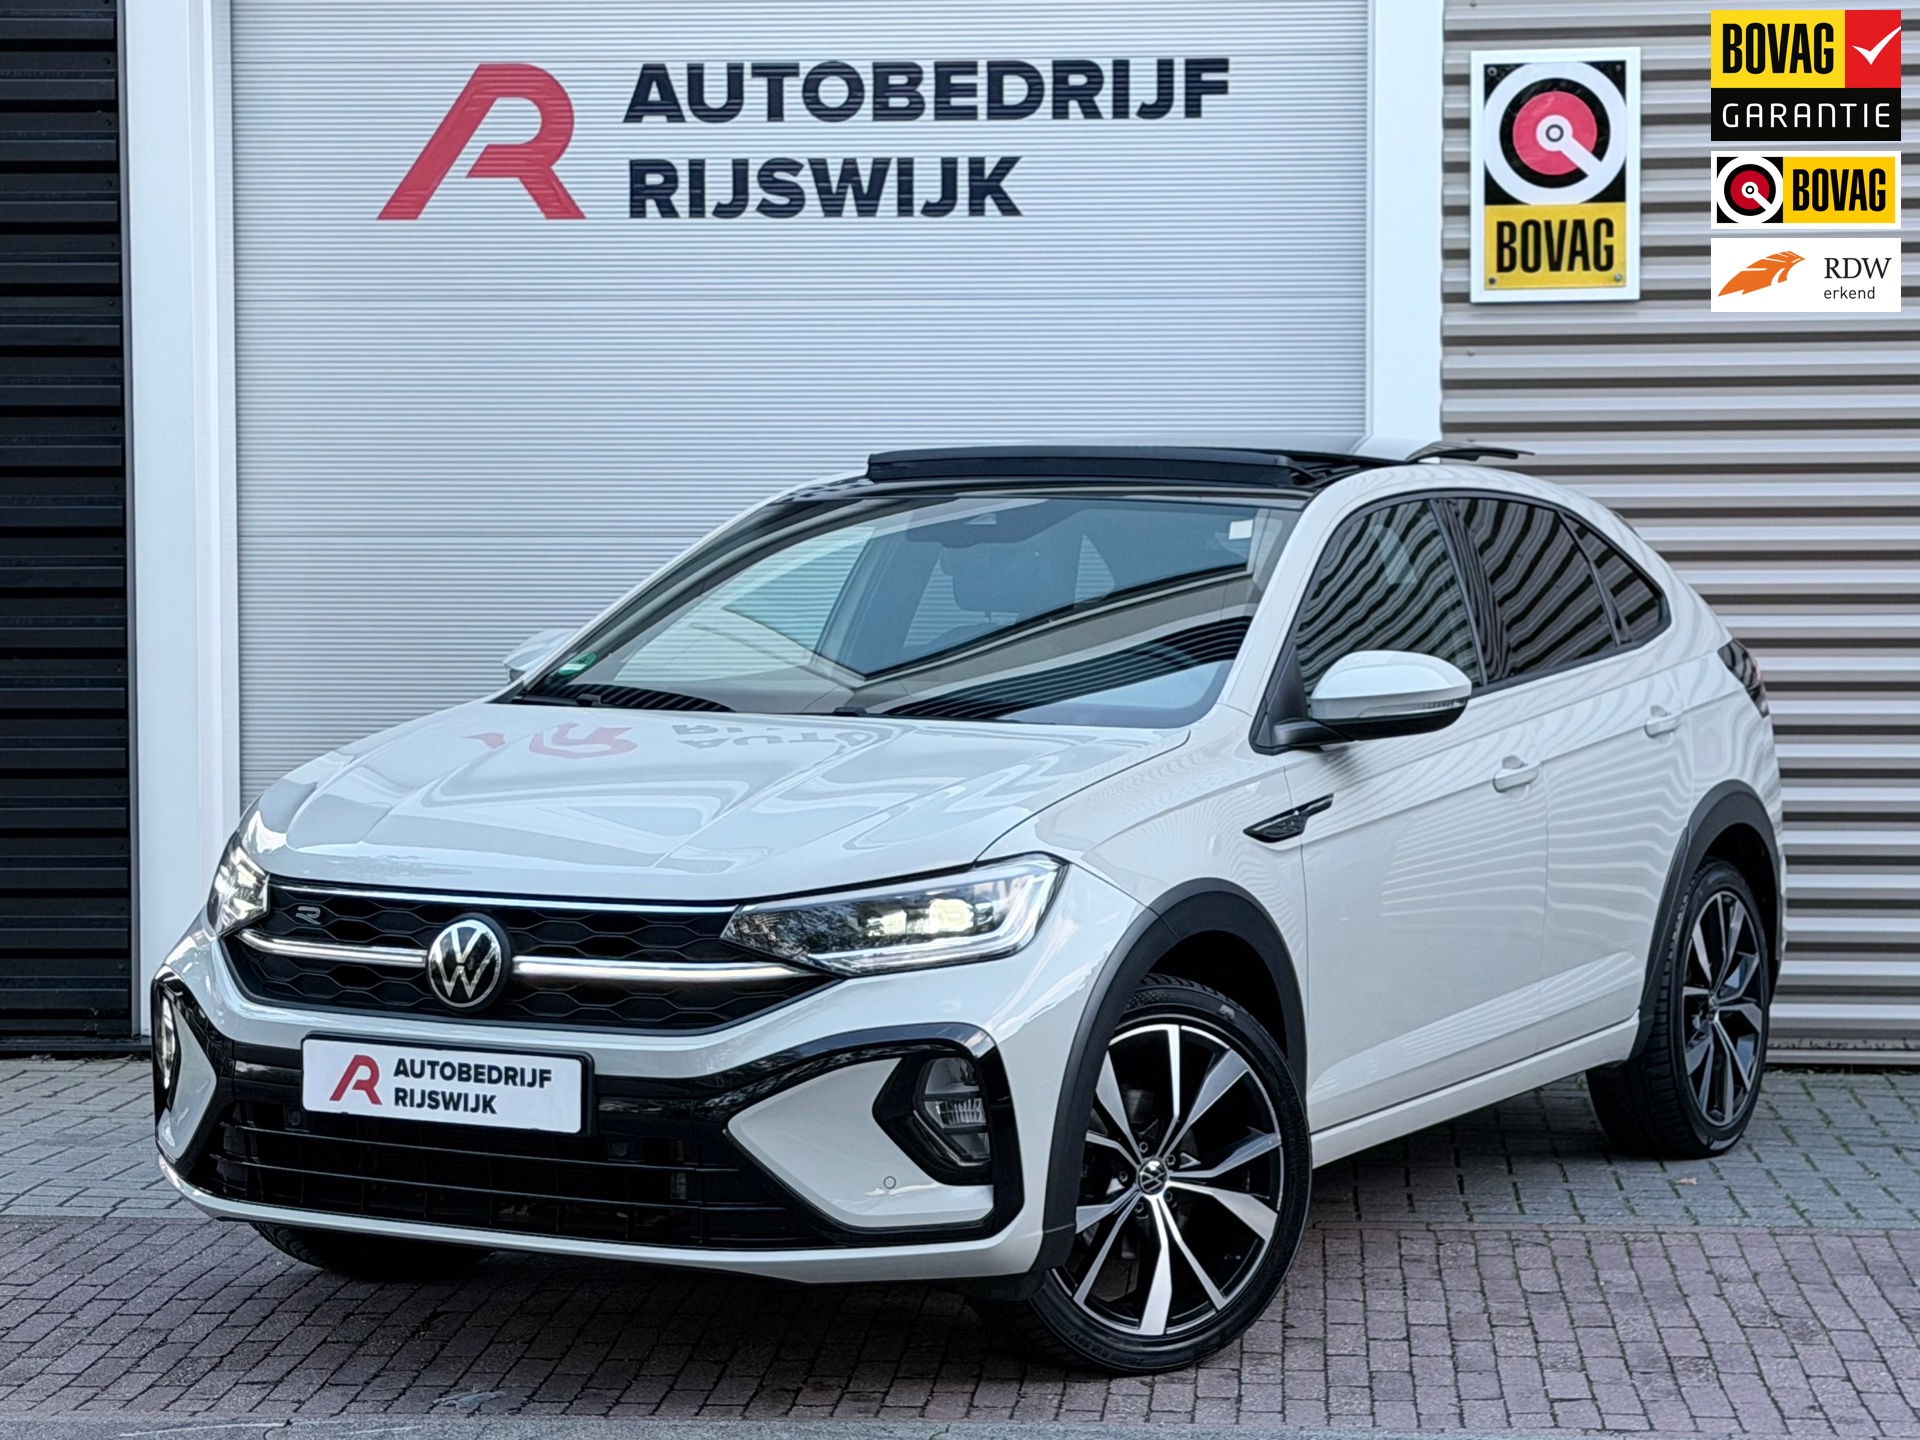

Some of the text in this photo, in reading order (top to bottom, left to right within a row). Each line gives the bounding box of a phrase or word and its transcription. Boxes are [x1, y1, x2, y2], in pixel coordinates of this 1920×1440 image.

[622, 57, 1229, 124] AUTOBEDRIJF
[628, 156, 1022, 219] RIJSWIJK
[1496, 217, 1614, 273] BOVAG
[393, 1057, 552, 1088] AUTOBEDRIJF
[394, 1087, 497, 1114] RIJSWIJK
